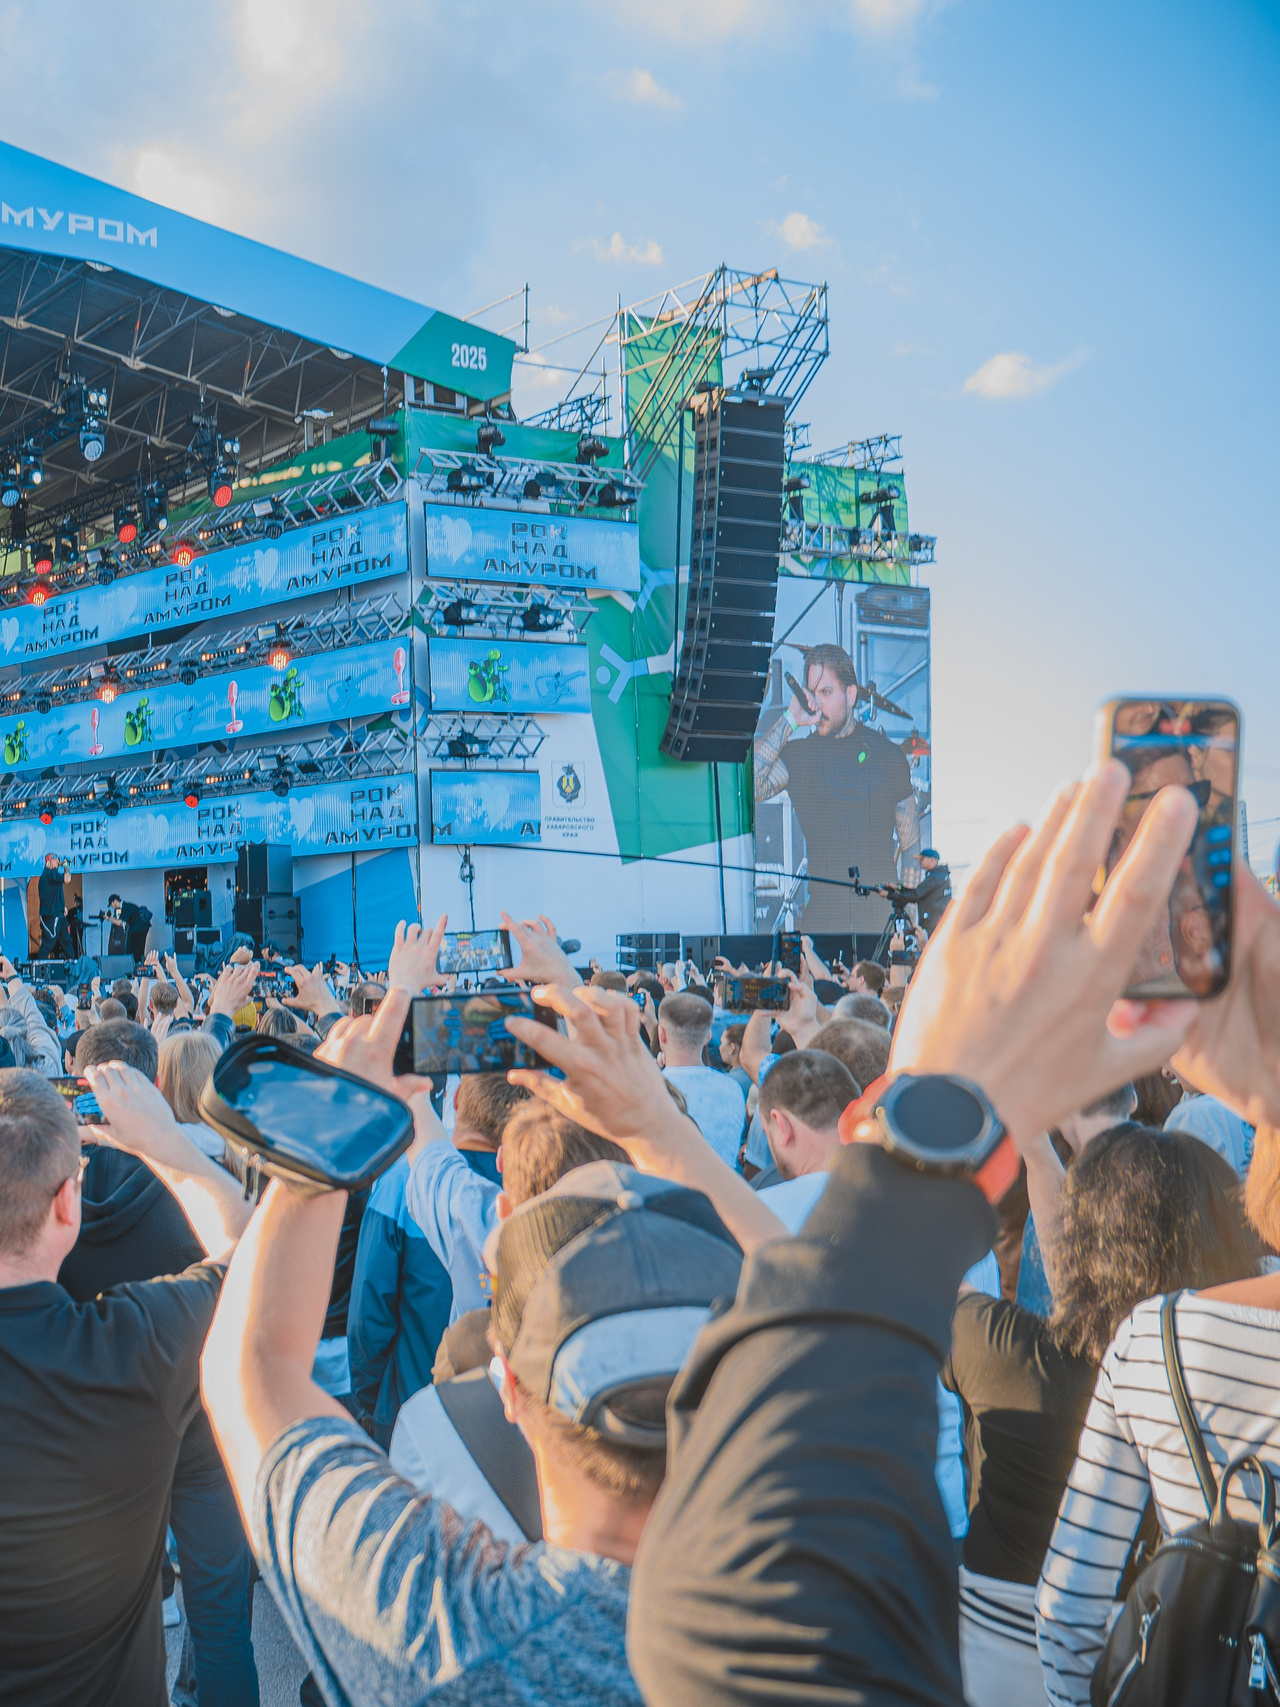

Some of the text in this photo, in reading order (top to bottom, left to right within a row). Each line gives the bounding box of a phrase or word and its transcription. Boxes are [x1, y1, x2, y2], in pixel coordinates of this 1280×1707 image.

[452, 343, 487, 371] 2025
[312, 521, 362, 547] РОК
[512, 522, 567, 540] РОК
[312, 540, 362, 566] НАД
[512, 541, 567, 558] НАД
[166, 563, 208, 586] РОК
[287, 553, 391, 592] АМУРОМ
[483, 558, 597, 580] АМУРОМ
[166, 582, 208, 602] НАД
[43, 596, 79, 619] РОК
[144, 594, 231, 626] АМУРОМ
[43, 614, 80, 634] НАД
[25, 625, 99, 655] АМУРОМ
[351, 783, 403, 804] РОК
[198, 802, 241, 821] РОК
[351, 804, 404, 822] НАД
[71, 818, 108, 834] РОК
[198, 821, 242, 838] НАД
[326, 824, 418, 846] АМУРО
[71, 835, 109, 850] НАД
[58, 850, 129, 868] МУРОМ
